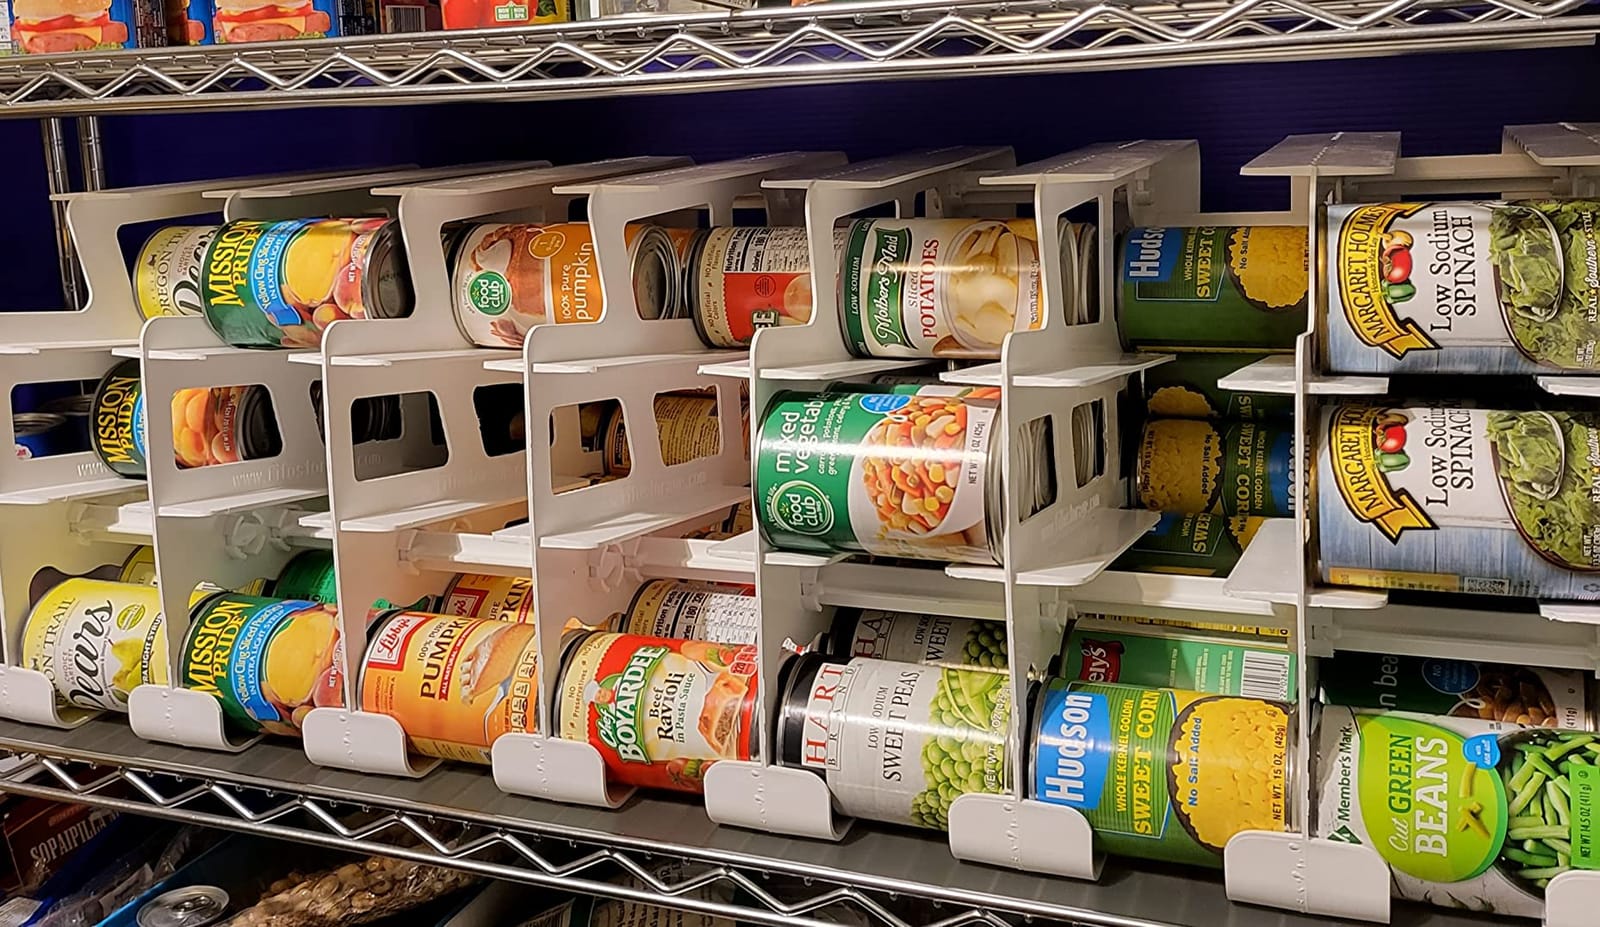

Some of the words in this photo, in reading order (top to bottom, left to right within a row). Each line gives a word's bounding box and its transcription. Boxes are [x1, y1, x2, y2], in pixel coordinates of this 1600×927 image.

[1349, 207, 1387, 252] HOLMES
[1582, 211, 1593, 233] STYLE
[232, 229, 264, 287] PRIDE
[270, 239, 283, 261] LIGHT
[724, 240, 739, 273] Nutrition
[877, 234, 899, 283] Maid
[1427, 210, 1451, 275] Sodium
[208, 221, 267, 307] MISSION
[254, 257, 269, 280] Cling
[267, 261, 277, 289] EXTRA
[561, 264, 572, 291] pure
[705, 267, 711, 277] NO
[751, 250, 762, 273] Calories
[852, 256, 860, 292] SODIUM
[1196, 238, 1213, 299] SWEET
[1239, 256, 1247, 270] No
[1451, 215, 1477, 316] SPINACH
[1585, 239, 1599, 288] Southern
[257, 280, 272, 309] Yellow
[270, 290, 278, 300] IN
[478, 279, 489, 308] food
[488, 280, 500, 308] club
[572, 242, 594, 320] pumpkin
[908, 270, 919, 308] Sliced
[919, 239, 940, 339] POTATOES
[561, 295, 572, 320] 100%
[852, 295, 860, 315] LOW
[1348, 258, 1390, 339] MARGARET
[1430, 284, 1452, 332] Low
[1588, 295, 1598, 322] REAL
[709, 318, 715, 328] NO
[97, 376, 140, 465] MISSION
[117, 391, 138, 453] PRIDE
[971, 440, 980, 448] OZ
[1204, 445, 1213, 465] Salt
[1206, 434, 1214, 445] No
[1237, 423, 1255, 469] SWEET
[1449, 408, 1474, 490] SPINACH
[968, 471, 977, 485] NET
[1255, 450, 1266, 476] KERNEL
[1340, 428, 1383, 512] MARGARET
[1201, 465, 1211, 495] Added
[1254, 477, 1264, 510] GOLDEN
[1425, 455, 1449, 507] Low
[1591, 476, 1600, 503] REAL
[785, 493, 804, 526] food
[801, 496, 819, 527] club
[499, 578, 532, 623] PKIN
[43, 597, 76, 649] TRAIL
[239, 627, 256, 650] Sliced
[376, 618, 411, 659] Libby's
[913, 629, 924, 645] LOW
[142, 641, 152, 666] LIGHT
[188, 600, 256, 698] MISSION
[212, 613, 248, 679] PRIDE
[250, 631, 266, 657] LIGHT
[417, 640, 433, 662] 100%
[926, 618, 953, 662] WEET
[62, 651, 70, 682] CHOICE
[234, 651, 250, 674] Cling
[248, 657, 257, 686] EXTRA
[419, 616, 474, 700] PUMPKI
[443, 650, 458, 681] NATURAL
[236, 674, 250, 703] Yellow
[250, 685, 258, 695] IN
[441, 681, 449, 693] ALL
[568, 686, 576, 698] NO
[572, 669, 588, 719] Preservatives
[682, 672, 696, 699] Sauce
[894, 671, 920, 707] PEAS
[616, 646, 669, 763] BOYARDEE
[649, 687, 665, 719] Beef
[656, 671, 687, 743] Ravioli
[674, 698, 688, 731] Pasta
[806, 665, 845, 765] HART
[828, 667, 855, 766] BRAND
[872, 687, 889, 722] ODIUM
[1120, 698, 1134, 736] GOLDEN
[1136, 690, 1161, 739] CORN
[600, 708, 617, 748] Chef
[676, 731, 685, 743] in
[867, 725, 879, 749] LOW
[1191, 717, 1202, 752] Added
[1275, 724, 1287, 749] (425g)
[1045, 694, 1094, 802] Hudson
[1117, 736, 1131, 777] KERNEL
[1274, 751, 1285, 767] OZ.
[985, 768, 997, 791] NET
[1188, 754, 1199, 785] Salt
[1273, 768, 1283, 783] 15
[1388, 734, 1413, 815] GREEN
[1116, 777, 1127, 812] WHOLE
[1133, 746, 1152, 835] SWEET
[1188, 789, 1199, 806] No
[1273, 784, 1284, 802] WT.
[1337, 755, 1352, 822] Member's
[1415, 737, 1449, 858] BEANS
[1272, 803, 1282, 821] NET
[1580, 807, 1591, 818] OZ
[1388, 817, 1410, 852] Cut
[1580, 833, 1591, 845] WT
[1580, 845, 1591, 858] NET
